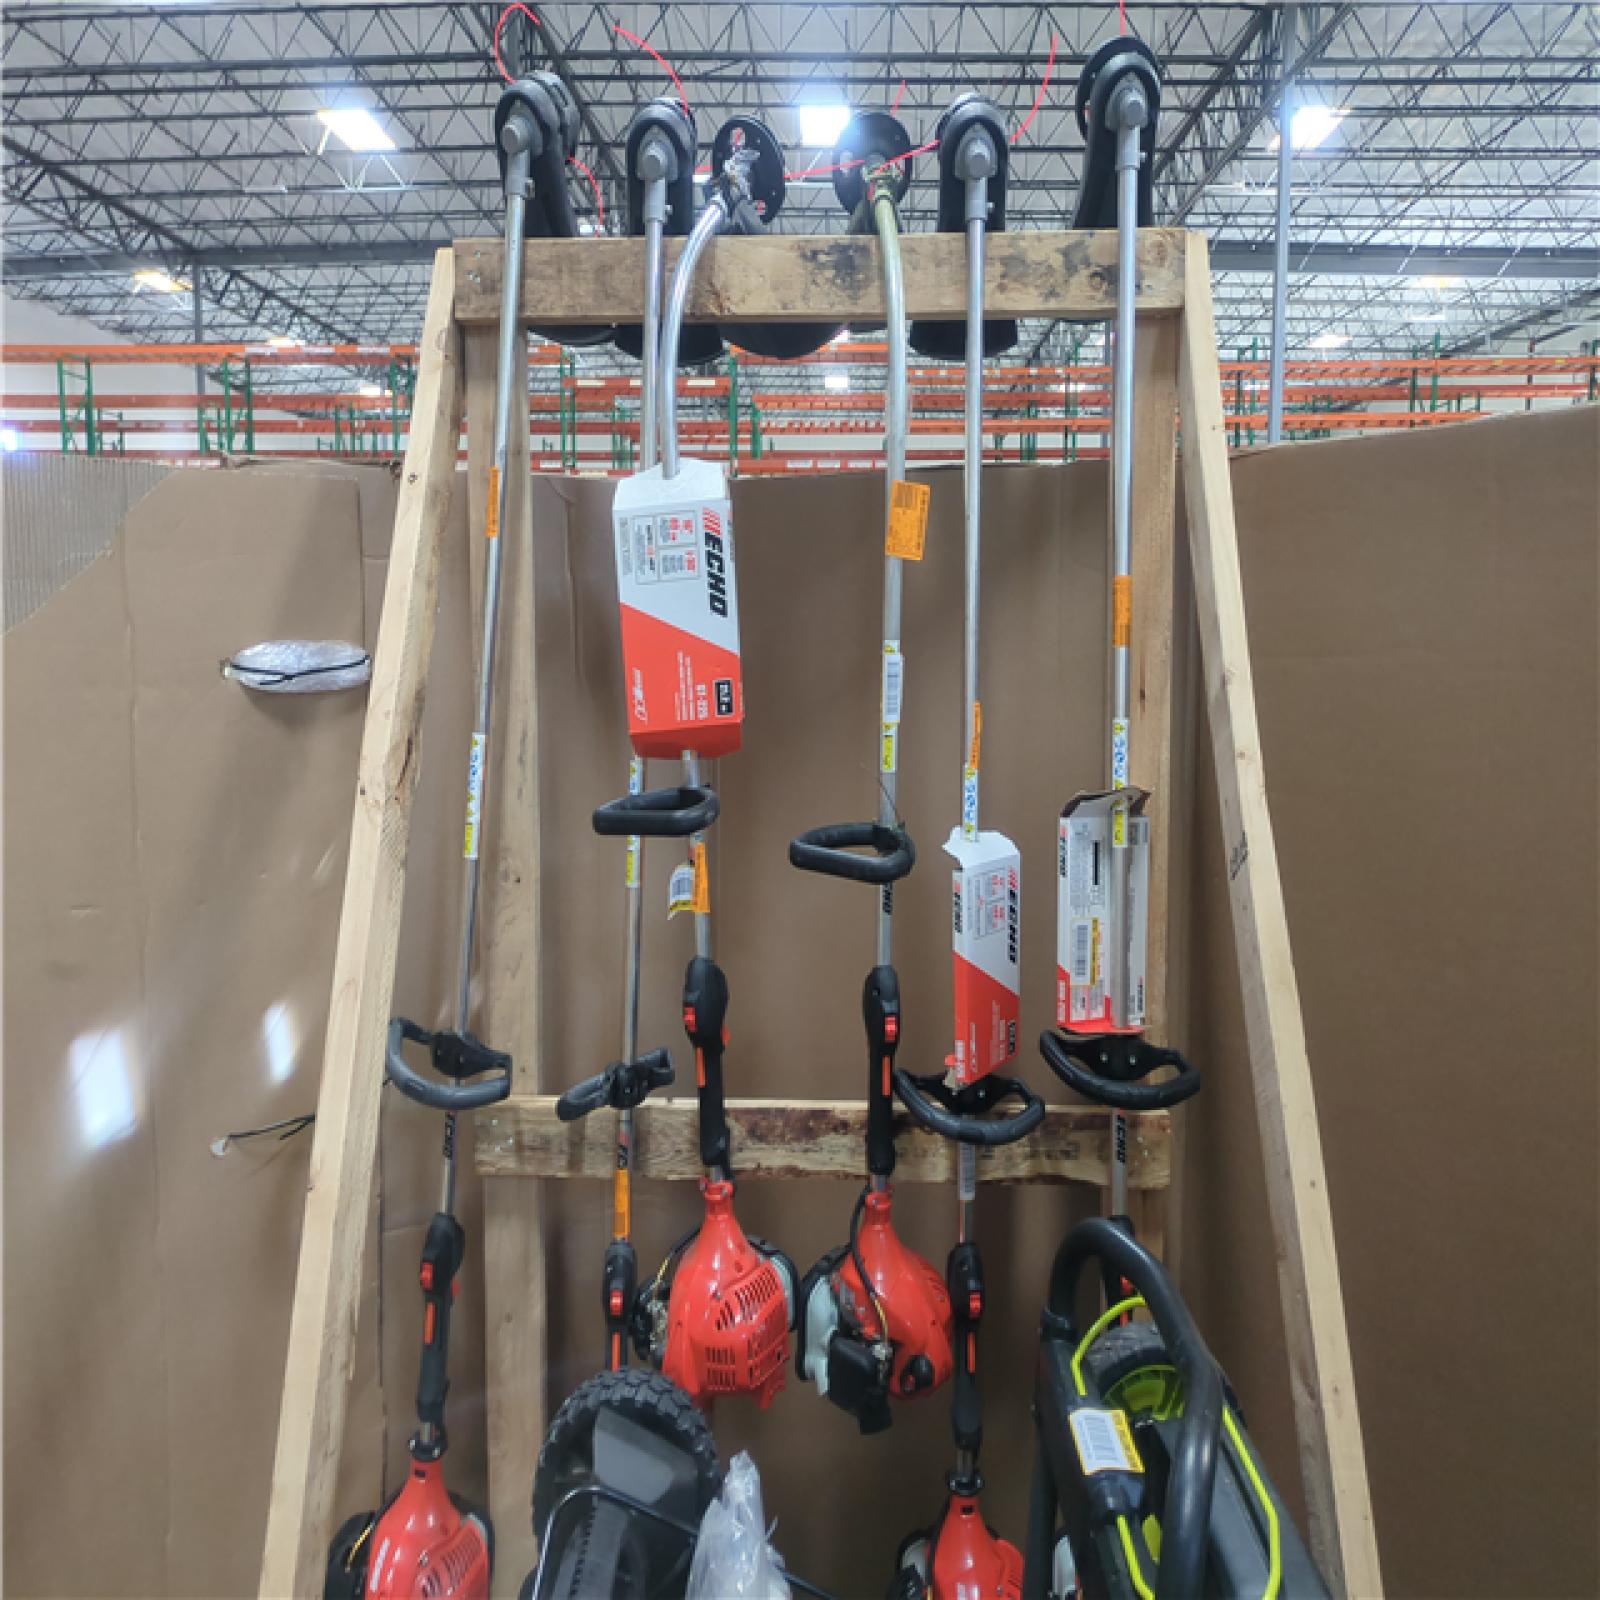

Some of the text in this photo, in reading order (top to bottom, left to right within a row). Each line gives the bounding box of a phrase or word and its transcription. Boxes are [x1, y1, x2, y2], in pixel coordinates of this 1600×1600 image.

[705, 531, 728, 618] ECHO
[883, 881, 892, 915] CHO
[1008, 890, 1018, 965] ECHO
[1116, 1115, 1126, 1163] ECHO
